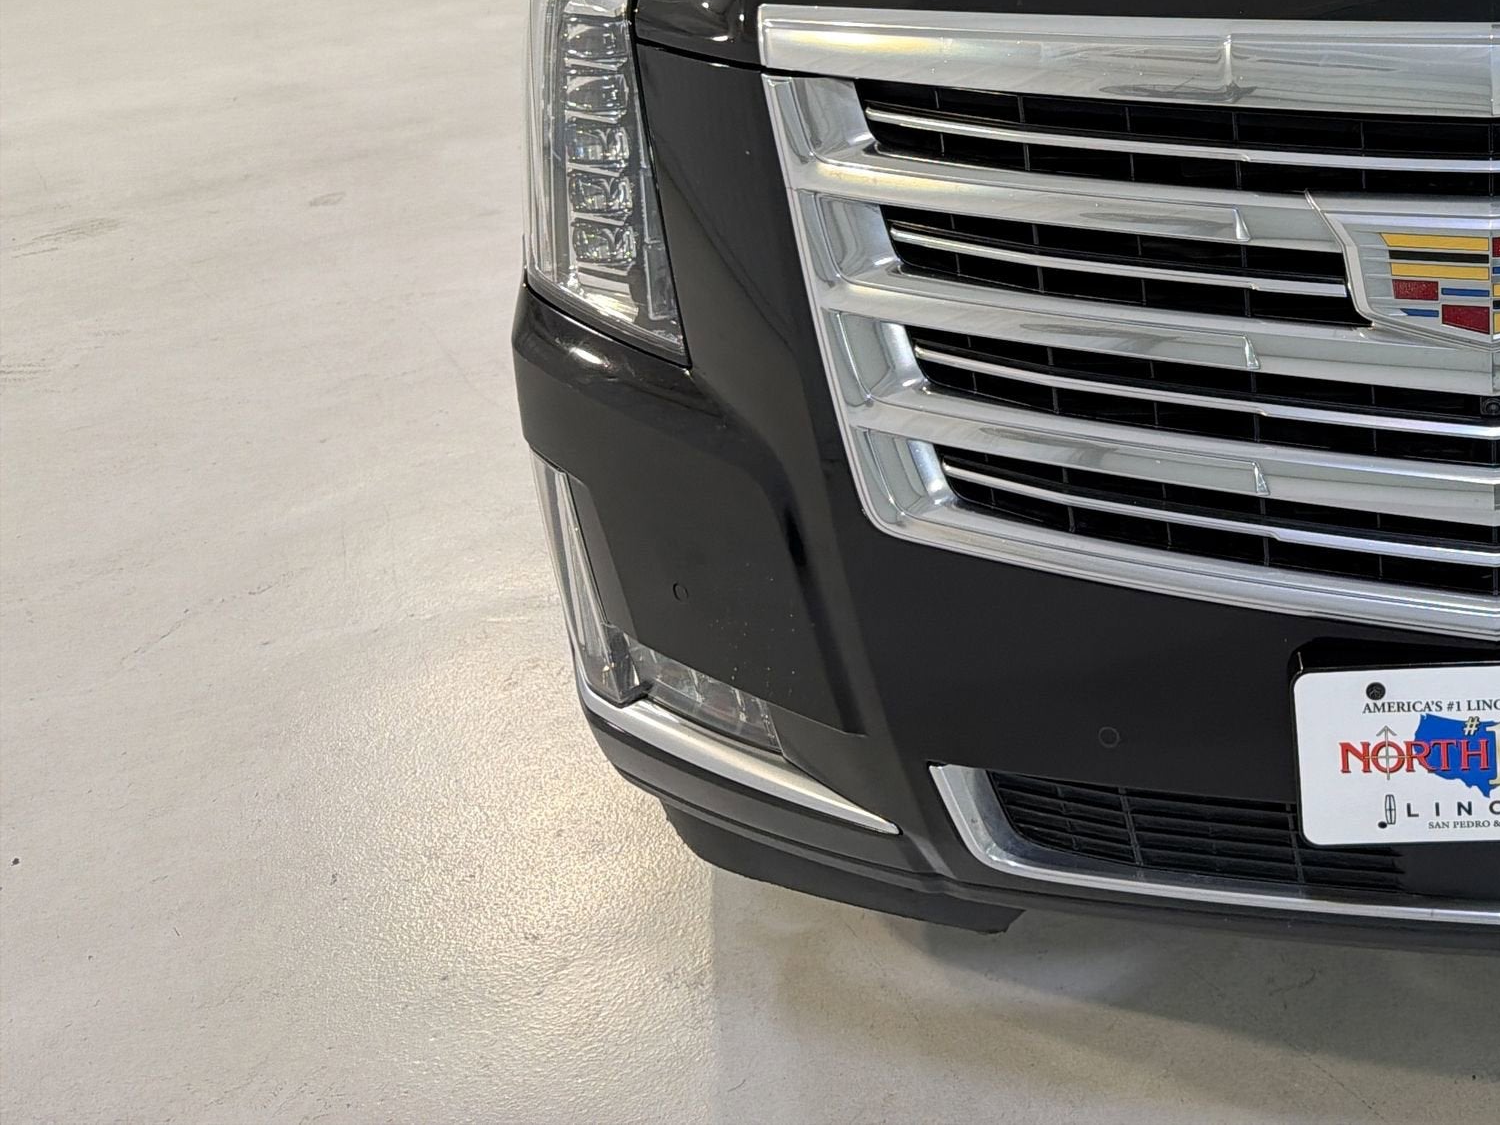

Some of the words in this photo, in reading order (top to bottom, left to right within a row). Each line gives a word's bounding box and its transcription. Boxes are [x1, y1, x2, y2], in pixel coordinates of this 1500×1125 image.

[1362, 700, 1443, 714] AMERICA'S
[1447, 700, 1464, 712] #1
[1339, 739, 1490, 774] NORTH
[1428, 821, 1450, 829] SAN
[1453, 819, 1491, 829] PEDRO
